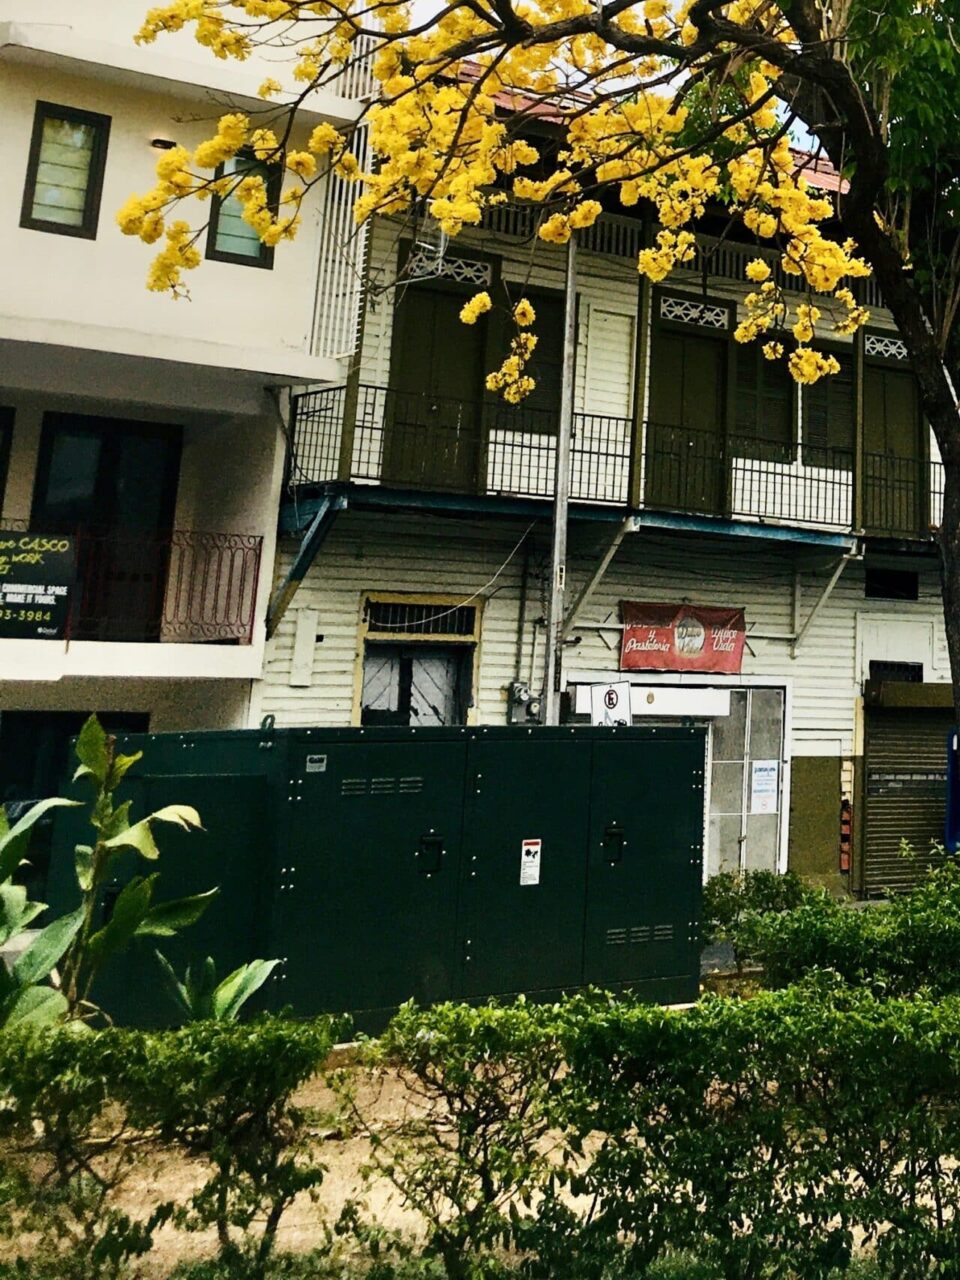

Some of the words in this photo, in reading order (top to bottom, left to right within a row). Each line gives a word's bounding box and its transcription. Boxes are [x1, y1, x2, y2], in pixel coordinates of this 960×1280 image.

[19, 537, 69, 552] CASCO
[47, 585, 68, 596] SPACE
[714, 639, 735, 651] Vida
